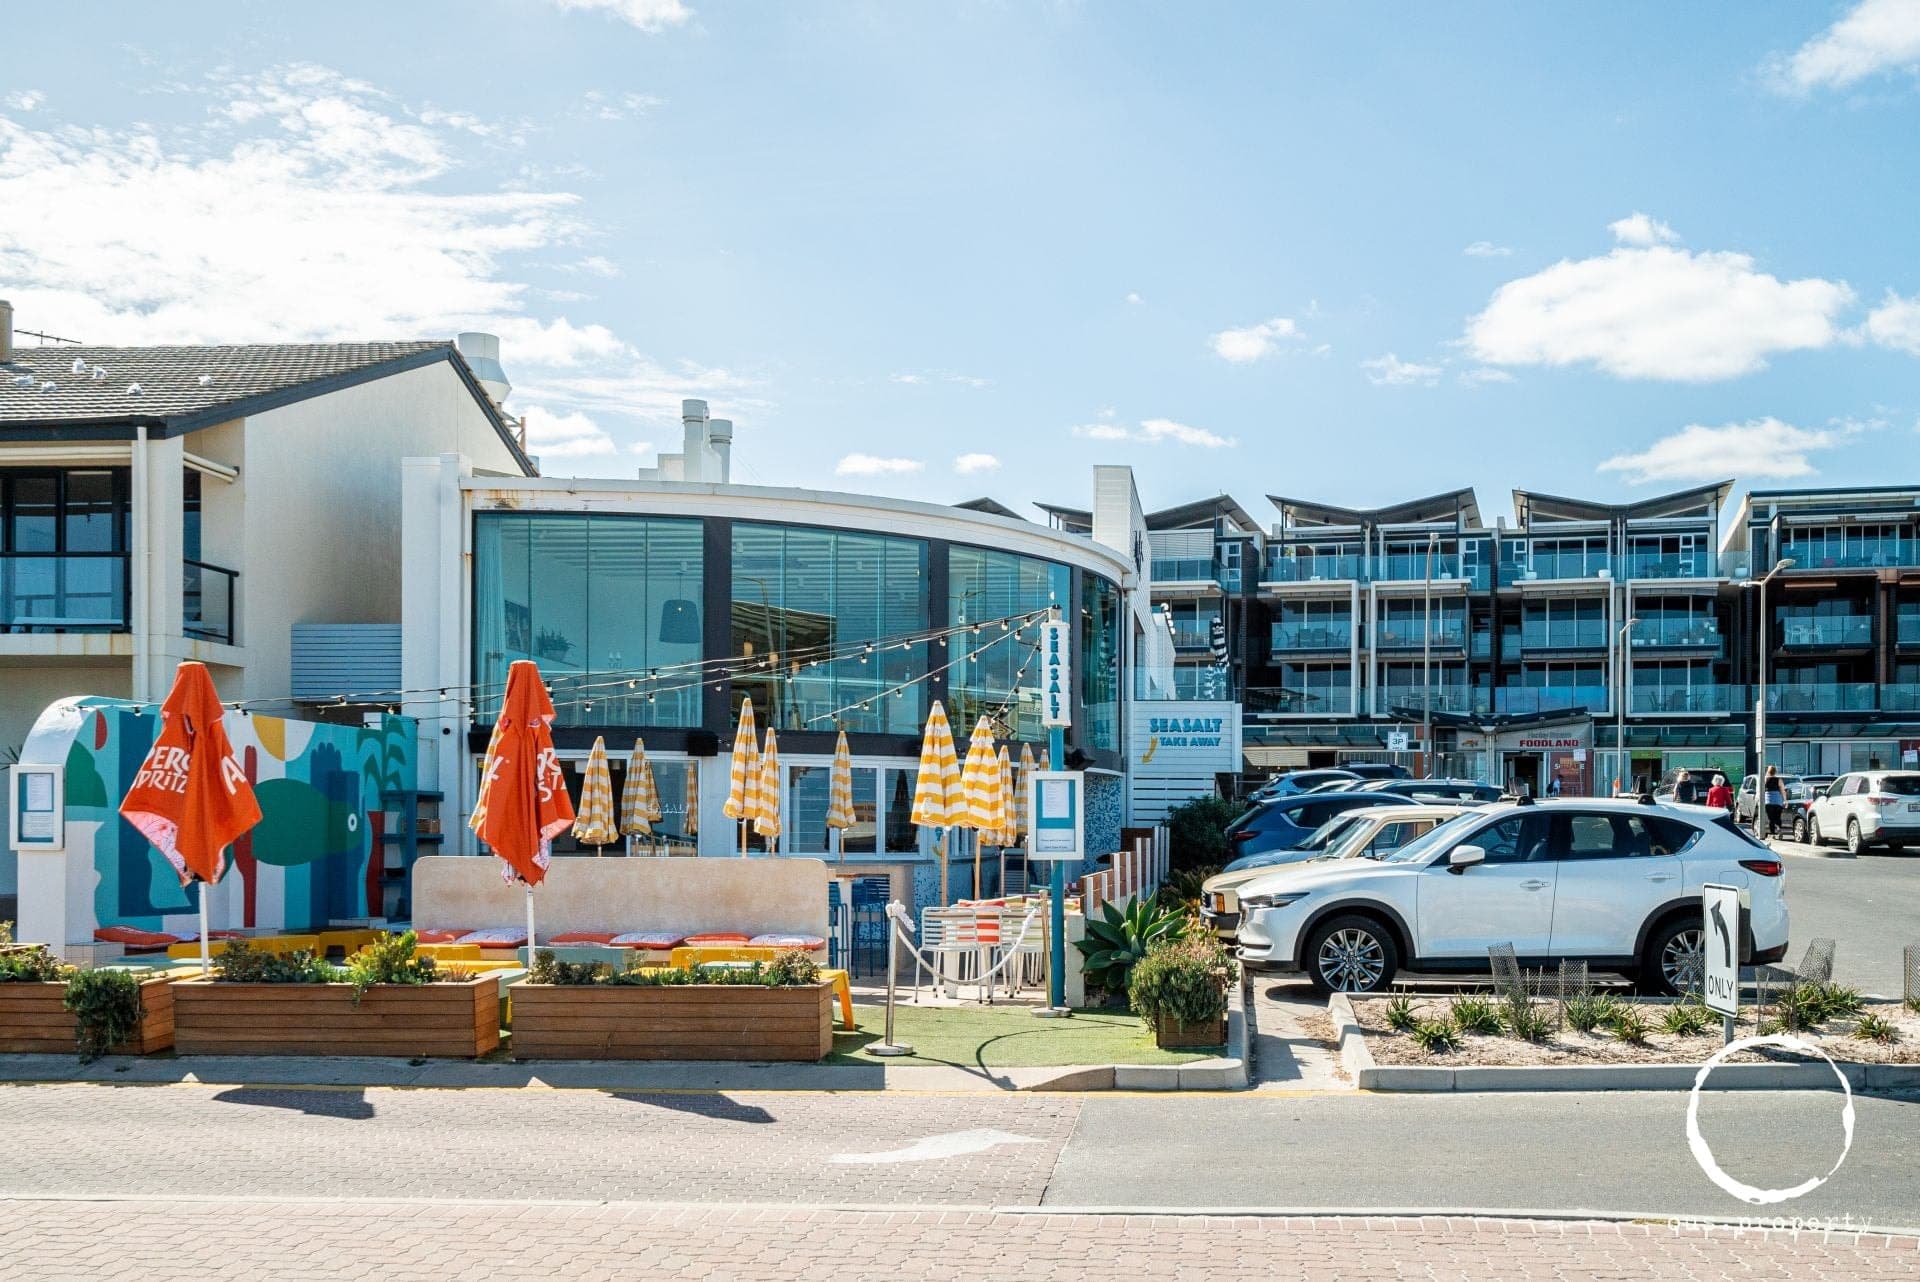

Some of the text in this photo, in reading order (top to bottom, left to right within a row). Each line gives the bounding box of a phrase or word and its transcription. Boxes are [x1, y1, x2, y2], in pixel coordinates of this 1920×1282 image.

[1048, 627, 1061, 719] SEASALT
[1150, 718, 1222, 733] SEASALT
[1160, 736, 1221, 747] TAKE AWAY
[1520, 739, 1579, 748] FOODLAND
[1708, 974, 1734, 1001] ONLY
